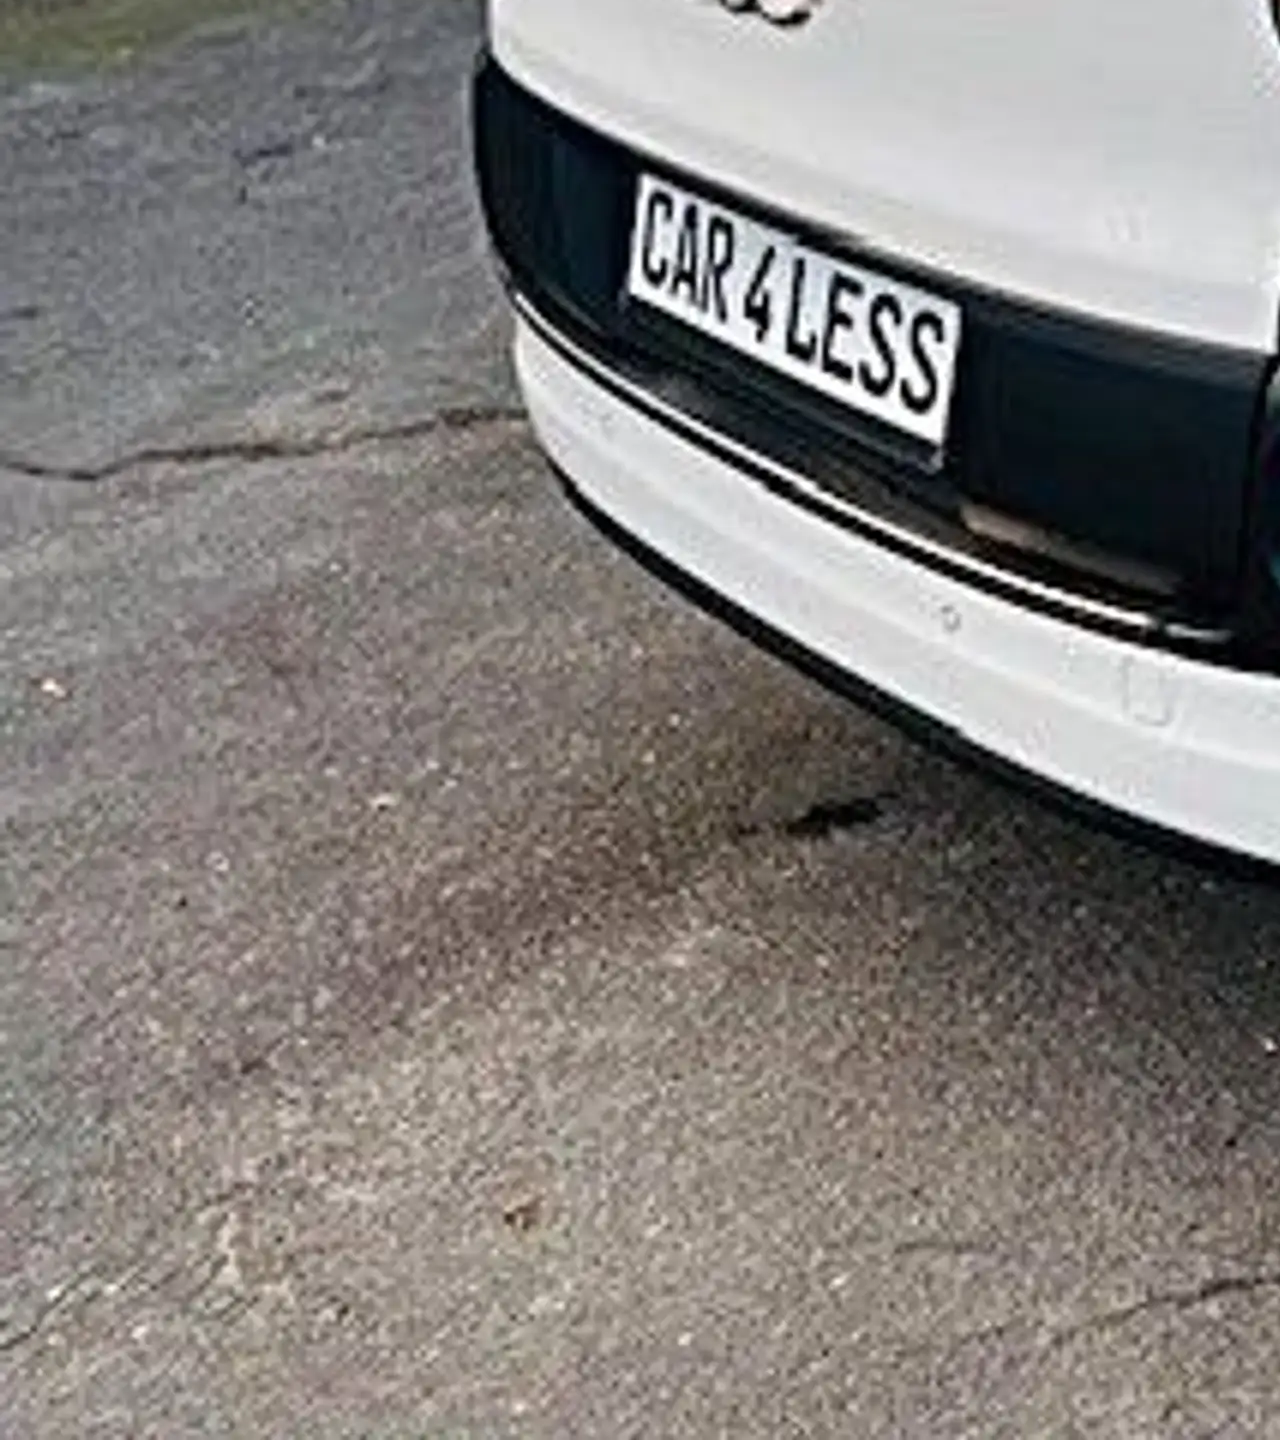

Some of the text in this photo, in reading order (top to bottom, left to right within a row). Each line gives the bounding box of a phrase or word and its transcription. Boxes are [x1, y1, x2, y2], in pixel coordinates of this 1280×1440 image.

[642, 189, 945, 416] CAR 4 LESS
